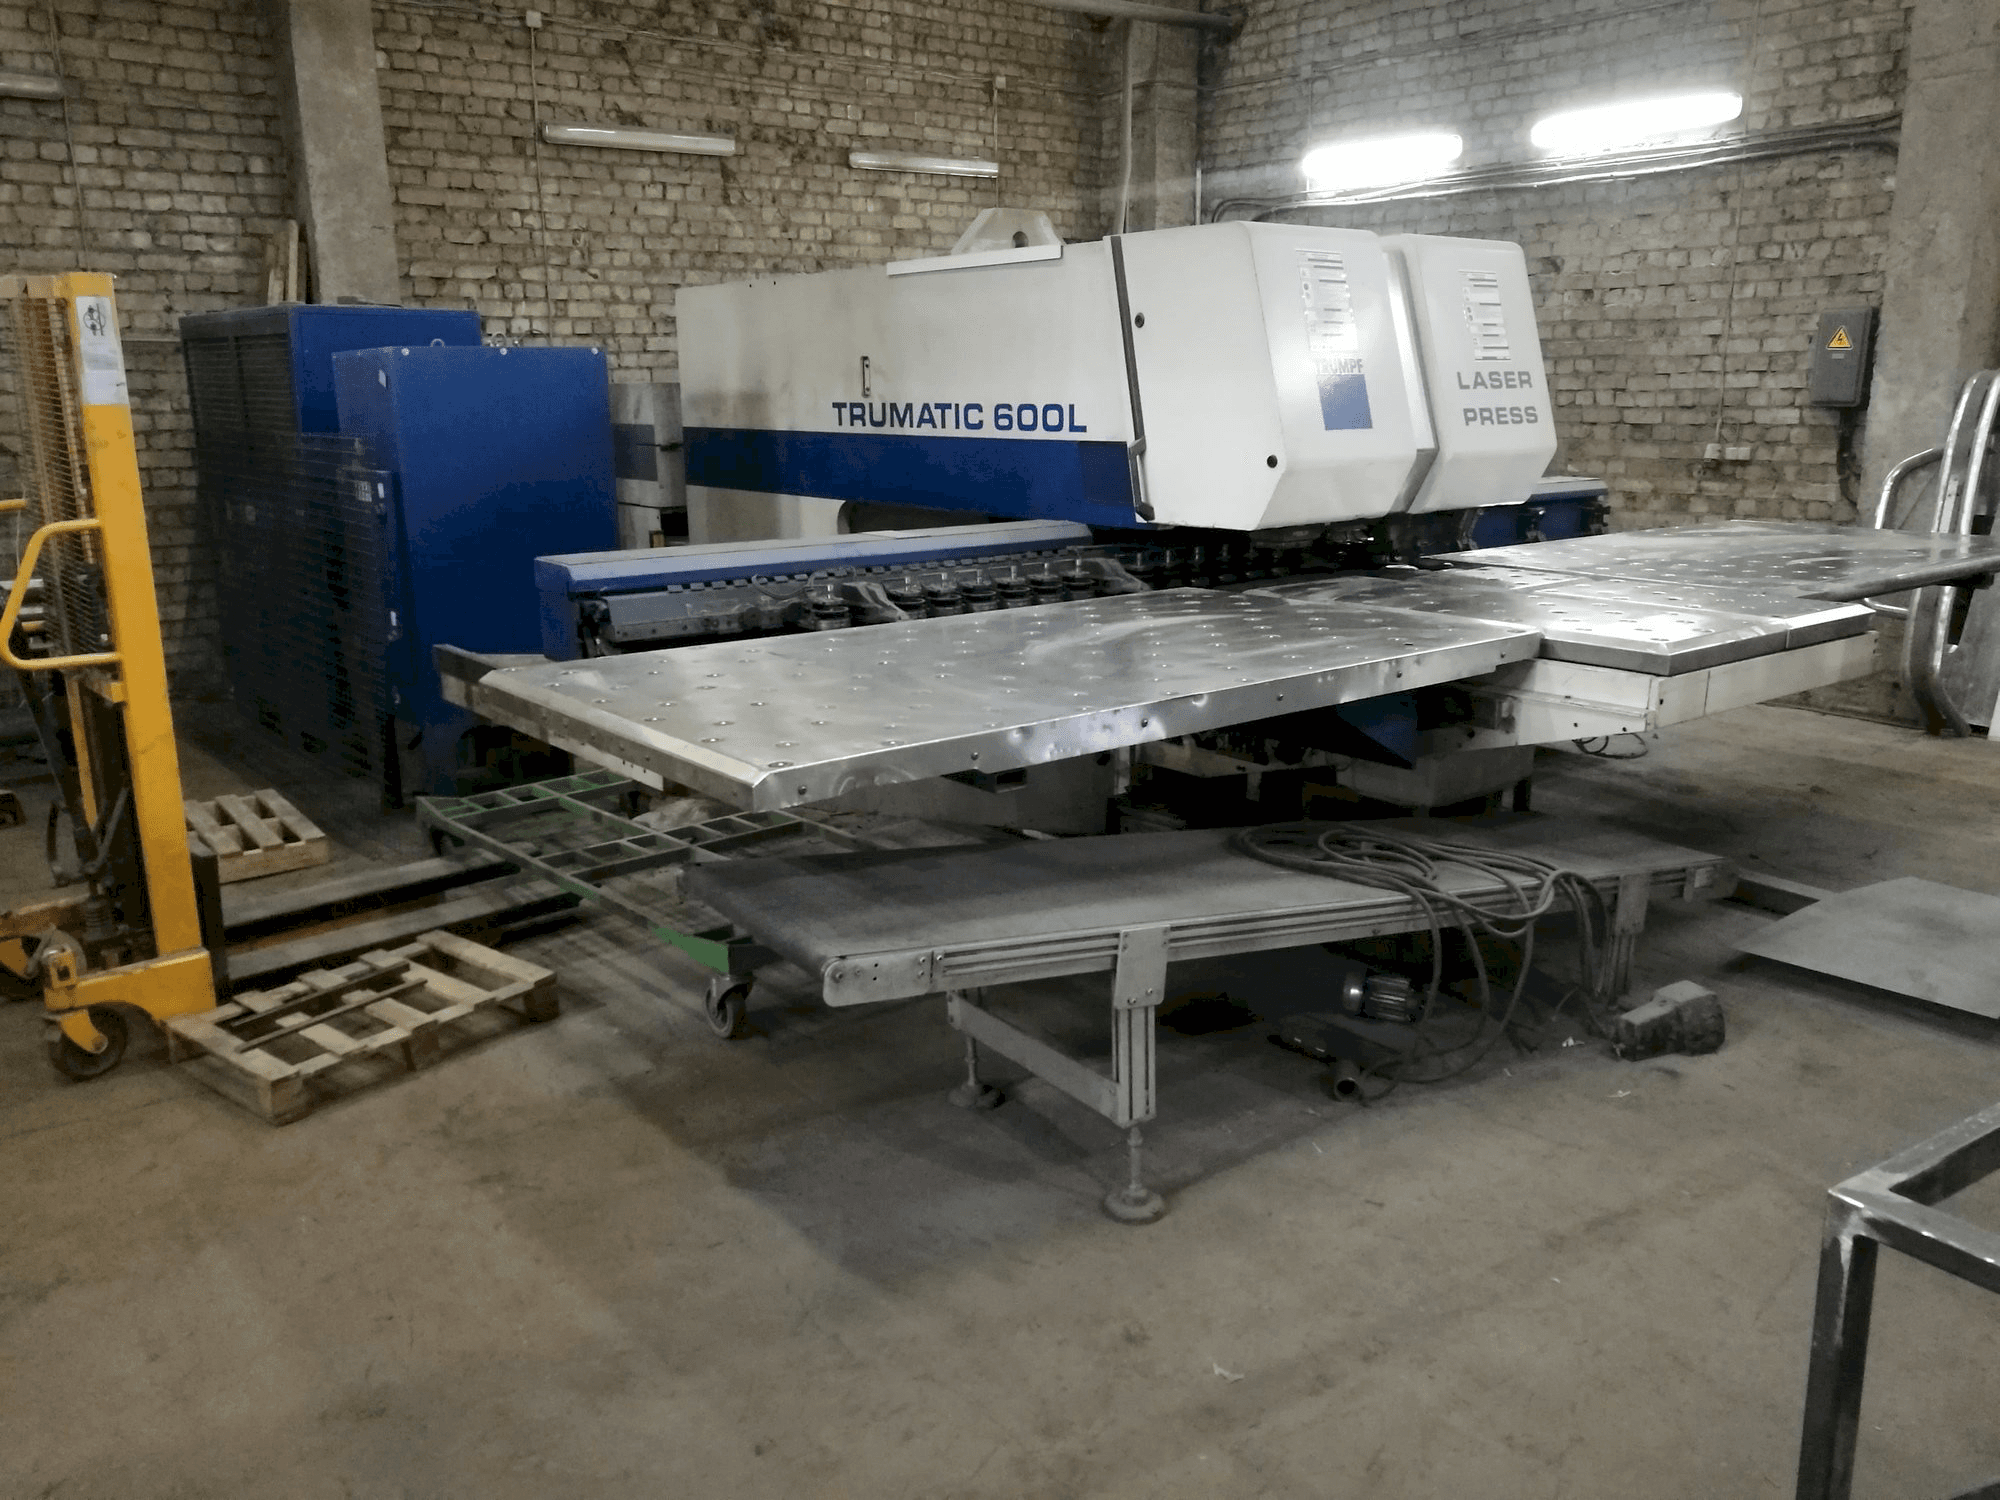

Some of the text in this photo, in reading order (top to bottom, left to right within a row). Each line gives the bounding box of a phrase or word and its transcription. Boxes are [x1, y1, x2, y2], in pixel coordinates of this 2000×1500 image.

[1457, 371, 1532, 390] LASER
[832, 402, 1087, 433] TRUMATIC 600L
[1463, 406, 1539, 426] PRESS
